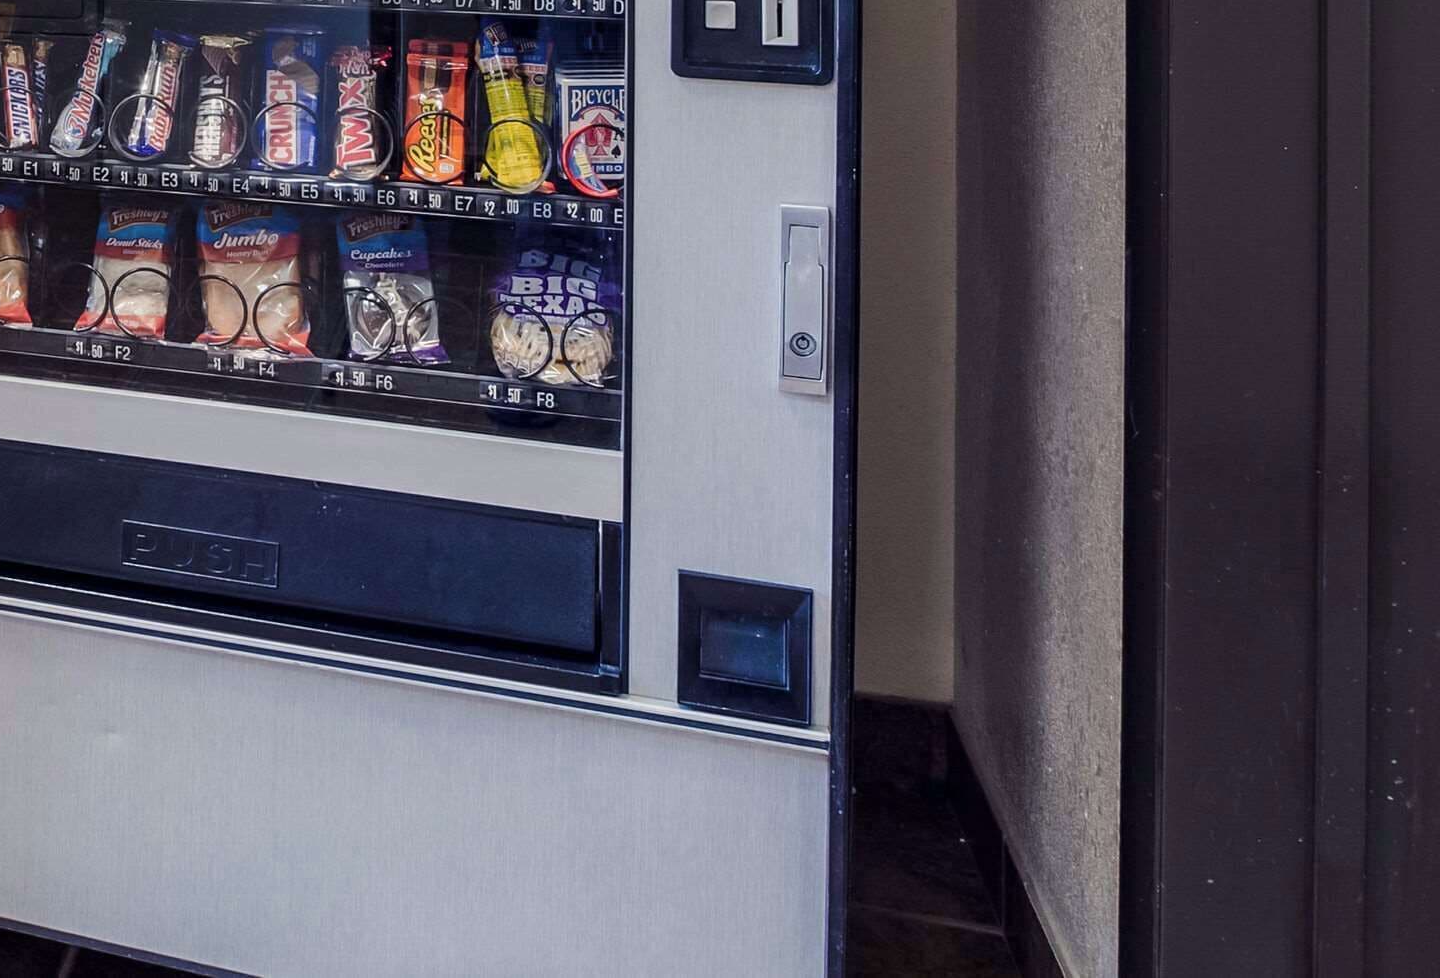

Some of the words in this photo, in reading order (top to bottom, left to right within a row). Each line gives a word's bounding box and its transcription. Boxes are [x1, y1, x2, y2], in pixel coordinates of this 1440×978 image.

[269, 74, 296, 164] CRUNCH
[24, 161, 39, 176] E1
[93, 167, 109, 182] E2
[162, 172, 178, 187] E3
[233, 178, 250, 193] E4
[301, 184, 318, 198] E5
[378, 190, 395, 205] E6
[455, 196, 474, 212] E7
[533, 202, 552, 218] E8
[106, 237, 137, 248] Donut
[214, 228, 279, 249] Jumbo
[511, 276, 599, 299] BIG
[116, 345, 131, 360] F2
[259, 362, 275, 377] F4
[375, 375, 393, 390] F6
[537, 393, 555, 408] F8
[129, 533, 276, 581] PUSH
